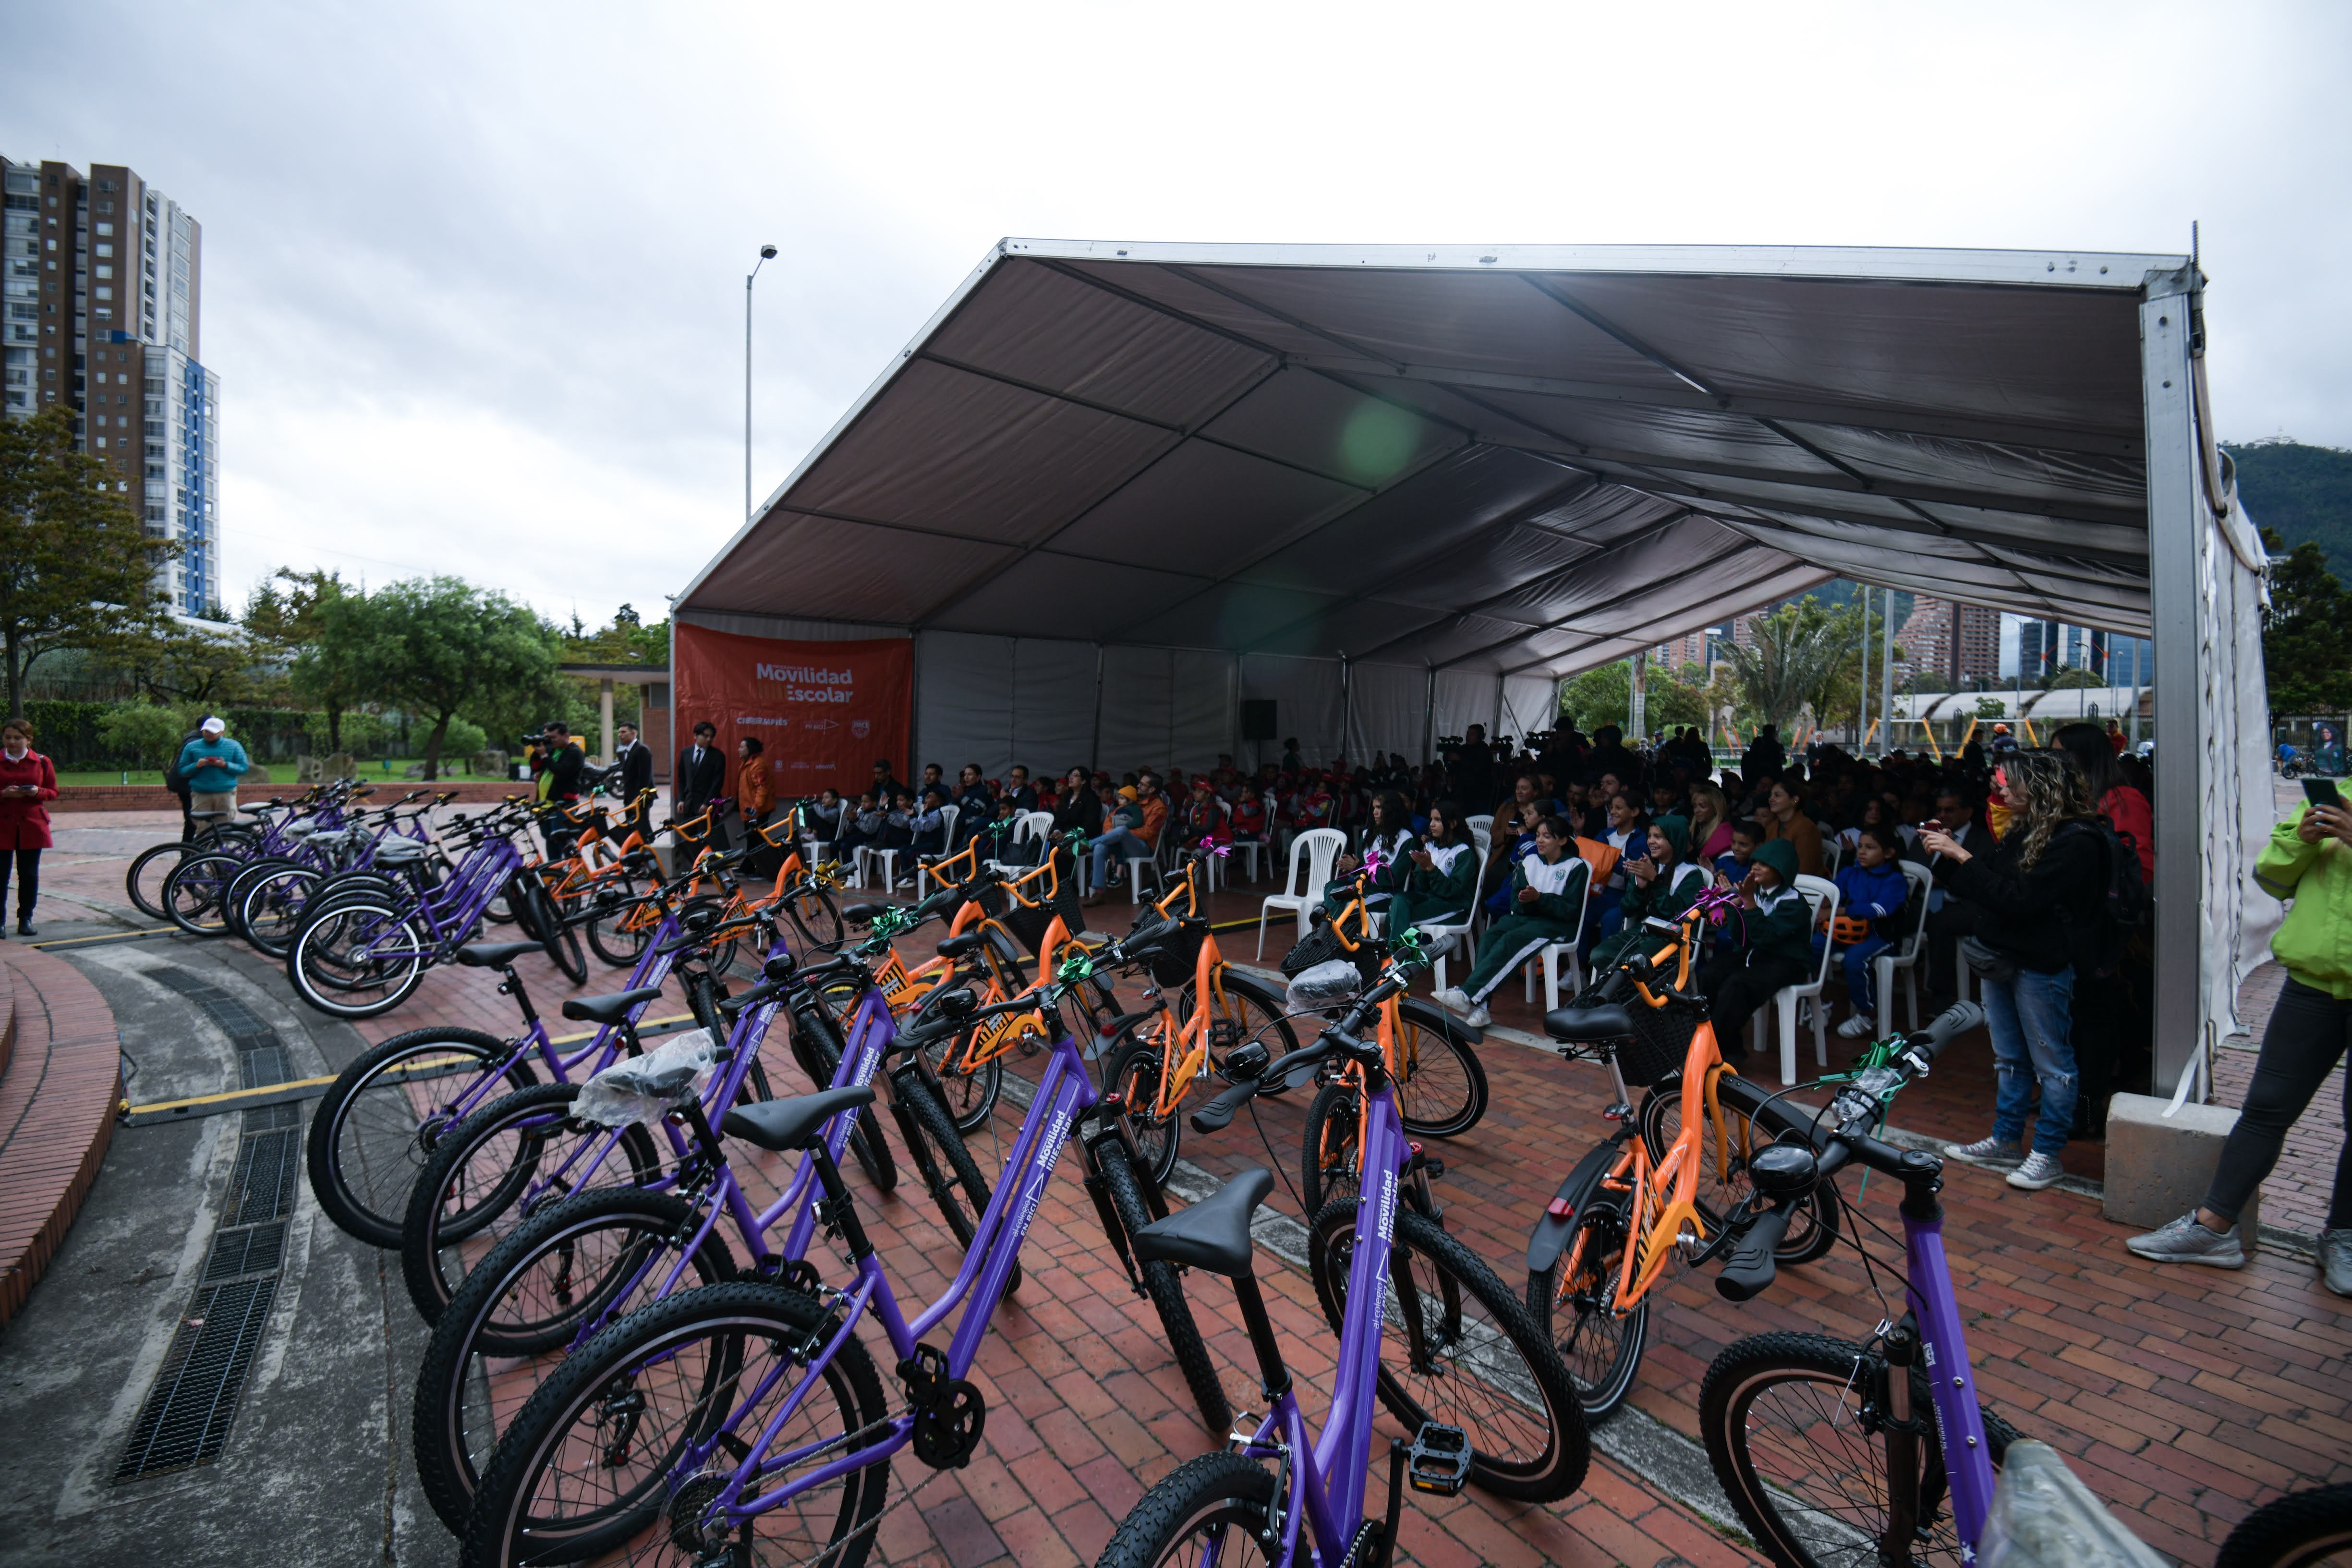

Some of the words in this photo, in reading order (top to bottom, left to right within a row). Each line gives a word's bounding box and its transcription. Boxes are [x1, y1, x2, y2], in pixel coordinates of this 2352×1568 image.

[757, 663, 853, 684] Movilidad
[787, 685, 853, 703] Escolar
[882, 976, 898, 991] Movilidad
[748, 1056, 754, 1064] EN
[866, 1051, 880, 1084] Escolar
[838, 1119, 849, 1142] colegio
[843, 1137, 849, 1148] EN
[1037, 1110, 1066, 1167] Movilidad
[1052, 1116, 1072, 1157] Escolar
[1378, 1169, 1393, 1240] Movilidad
[1389, 1175, 1399, 1226] Escolar
[1012, 1228, 1019, 1237] al
[1016, 1200, 1031, 1228] colegio
[1020, 1223, 1029, 1236] EN
[1027, 1203, 1037, 1222] BICI
[1374, 1283, 1383, 1318] colegio
[1372, 1319, 1379, 1329] al
